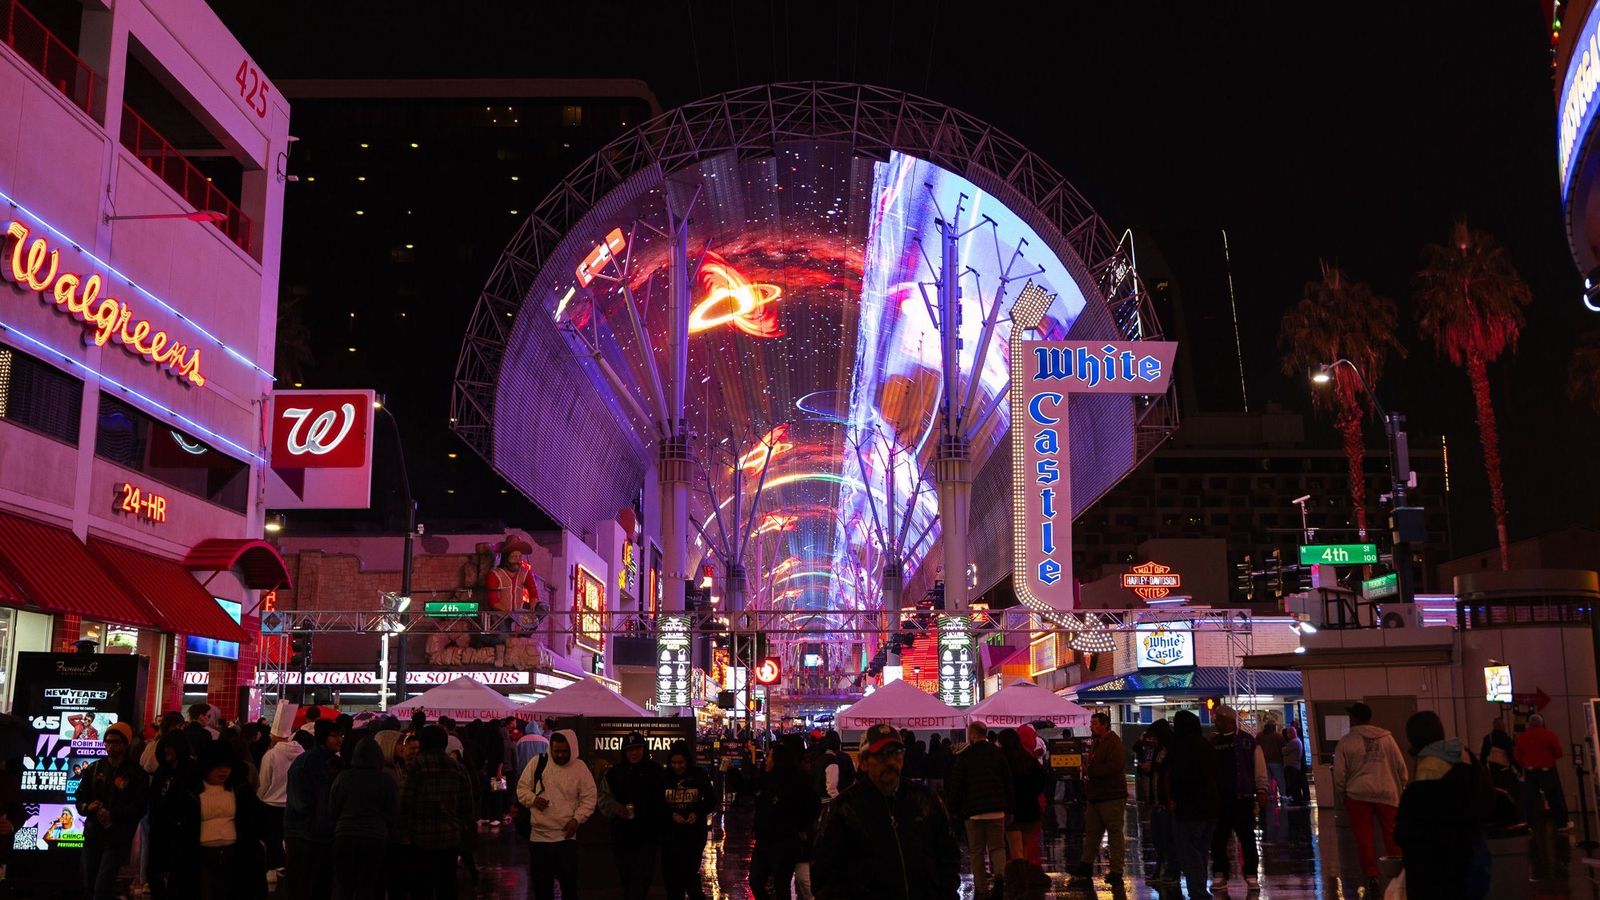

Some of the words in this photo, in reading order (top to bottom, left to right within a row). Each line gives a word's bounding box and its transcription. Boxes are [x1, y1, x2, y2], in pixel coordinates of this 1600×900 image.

[235, 59, 270, 119] 425
[7, 221, 206, 386] Walgreens
[1032, 344, 1161, 388] White
[281, 402, 356, 456] W
[1027, 391, 1064, 586] Castle
[122, 482, 167, 523] 24-HR
[1321, 547, 1349, 562] 4th
[1138, 564, 1165, 574] MOTOR
[1126, 576, 1177, 585] HARLEY-DAVIDSON
[440, 603, 459, 612] 4th
[1149, 637, 1180, 648] White
[1147, 648, 1182, 659] Castle
[313, 672, 373, 684] CIGARS
[70, 690, 107, 699] YEAR'S
[645, 697, 660, 711] the
[455, 709, 478, 719] WILL
[480, 710, 501, 719] CALL
[520, 713, 544, 722] WILL
[854, 717, 892, 727] CREDIT
[907, 717, 945, 727] CREDIT
[985, 715, 1025, 725] CREDIT
[22, 776, 36, 785] IN
[39, 776, 67, 785] THE
